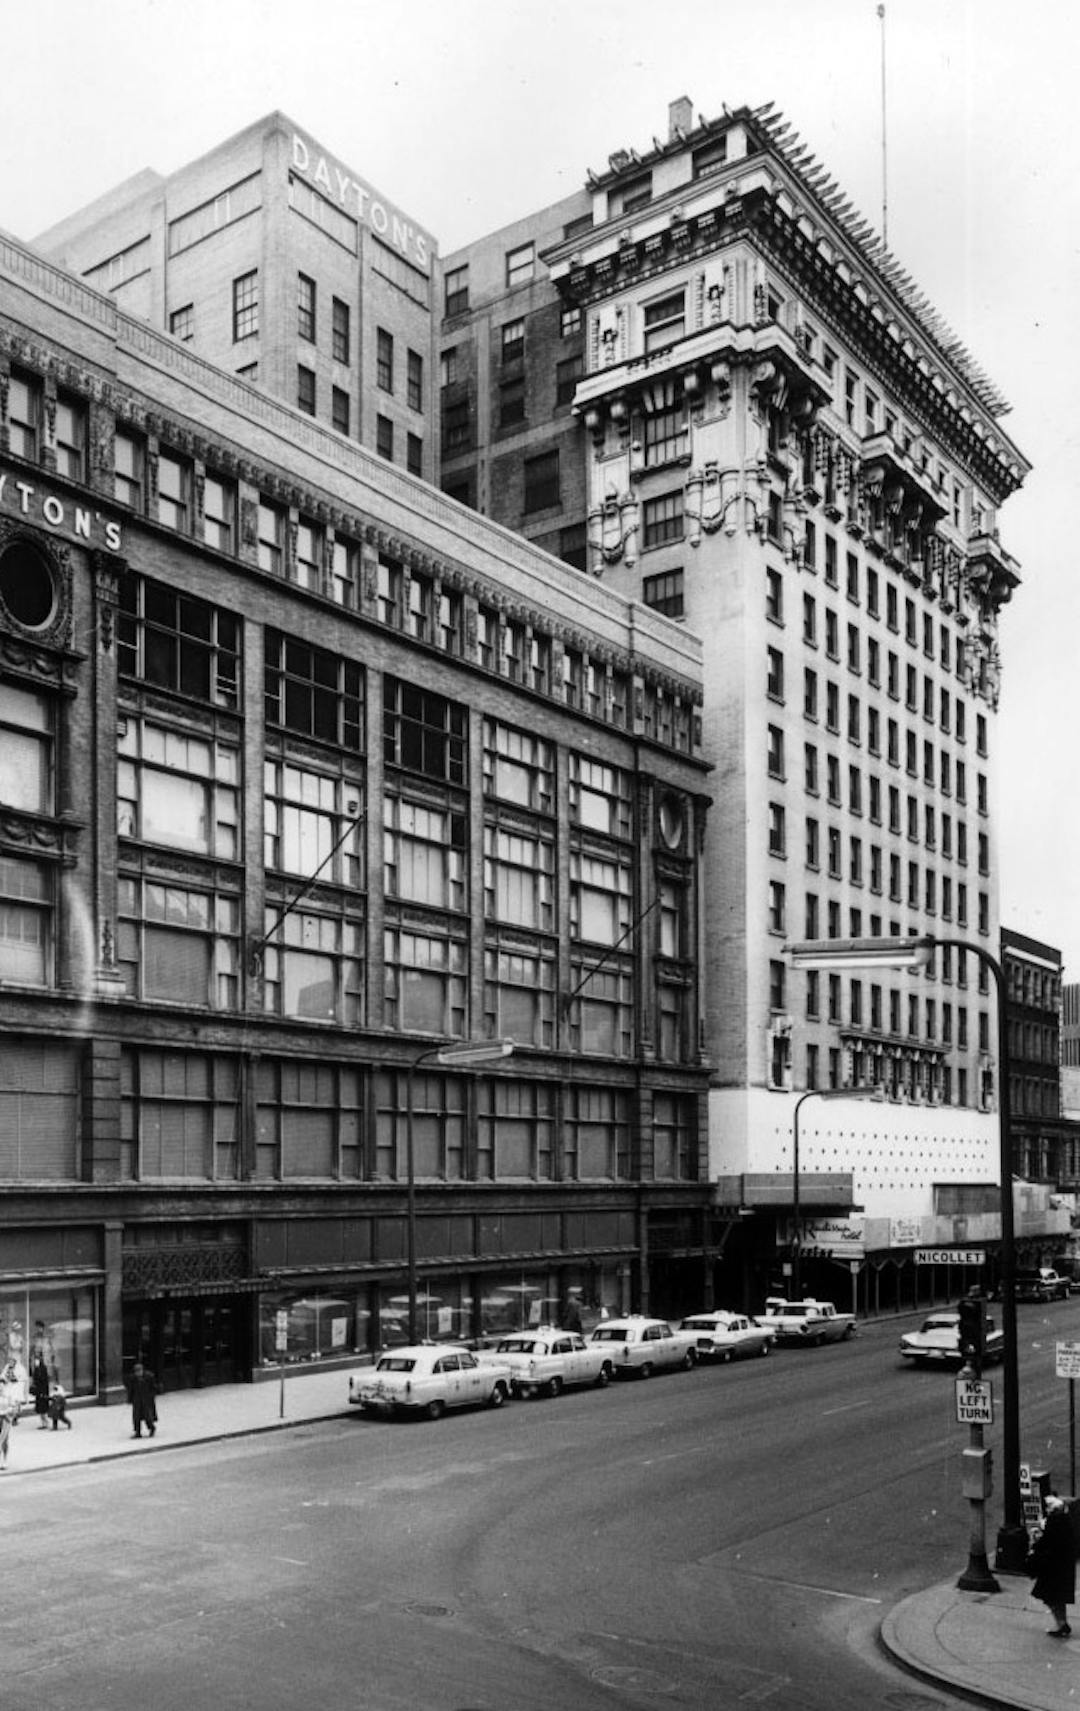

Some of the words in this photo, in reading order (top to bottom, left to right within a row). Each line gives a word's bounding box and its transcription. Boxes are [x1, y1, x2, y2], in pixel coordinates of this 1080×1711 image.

[293, 133, 427, 266] DAYTON'S
[918, 1252, 982, 1263] NICOLLET
[965, 1382, 983, 1393] NO
[960, 1395, 987, 1406] LEFT
[960, 1407, 989, 1419] TURN
